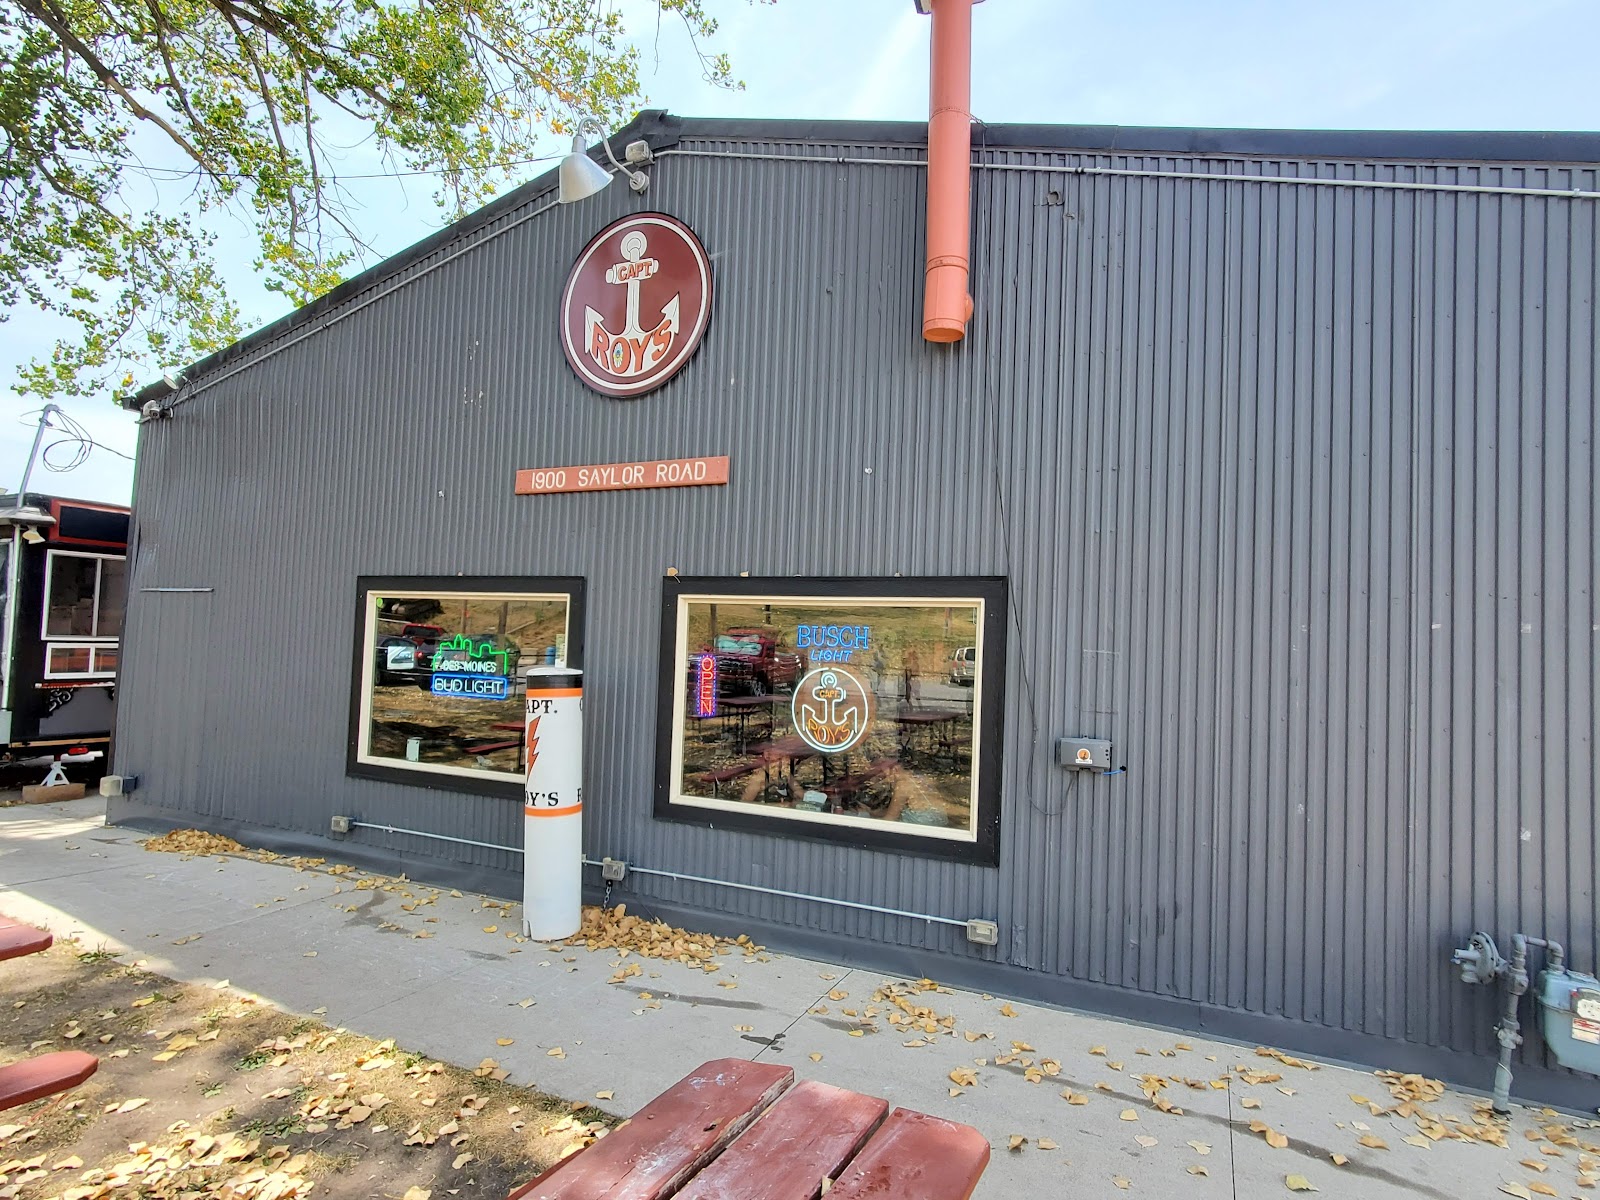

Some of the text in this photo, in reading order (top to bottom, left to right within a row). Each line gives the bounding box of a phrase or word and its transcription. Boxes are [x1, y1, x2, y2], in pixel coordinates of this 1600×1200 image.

[591, 319, 673, 374] ROY'S
[531, 461, 707, 489] 1900 SAYLOR ROAD
[796, 625, 870, 649] BUSCH
[463, 660, 497, 673] MOINES
[810, 649, 853, 662] LIGHT
[434, 678, 504, 694] BUD LIGHT
[701, 657, 713, 716] OPEN
